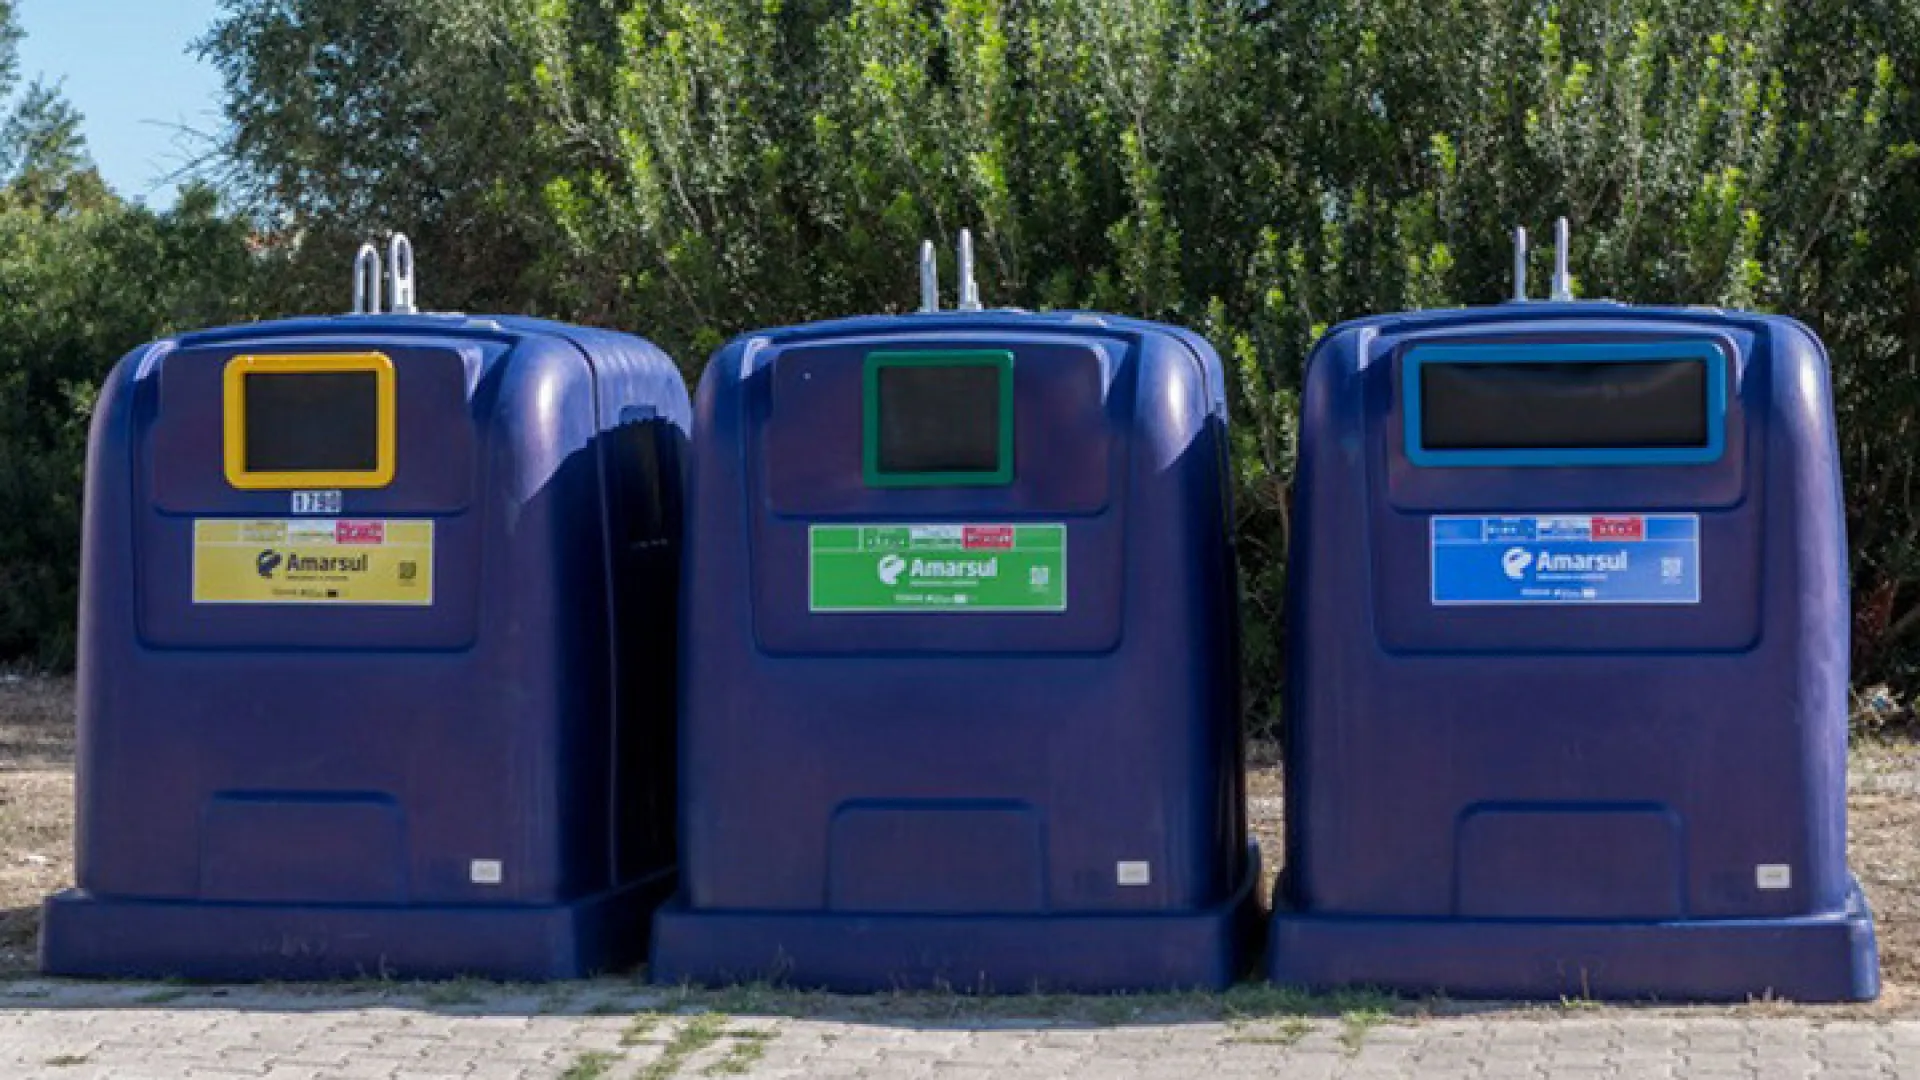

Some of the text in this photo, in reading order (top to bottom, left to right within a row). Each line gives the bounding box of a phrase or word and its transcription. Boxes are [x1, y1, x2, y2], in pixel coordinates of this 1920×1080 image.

[287, 553, 367, 572] Amarsul
[911, 557, 998, 577] Amarsul
[1537, 550, 1628, 571] Amarsul
